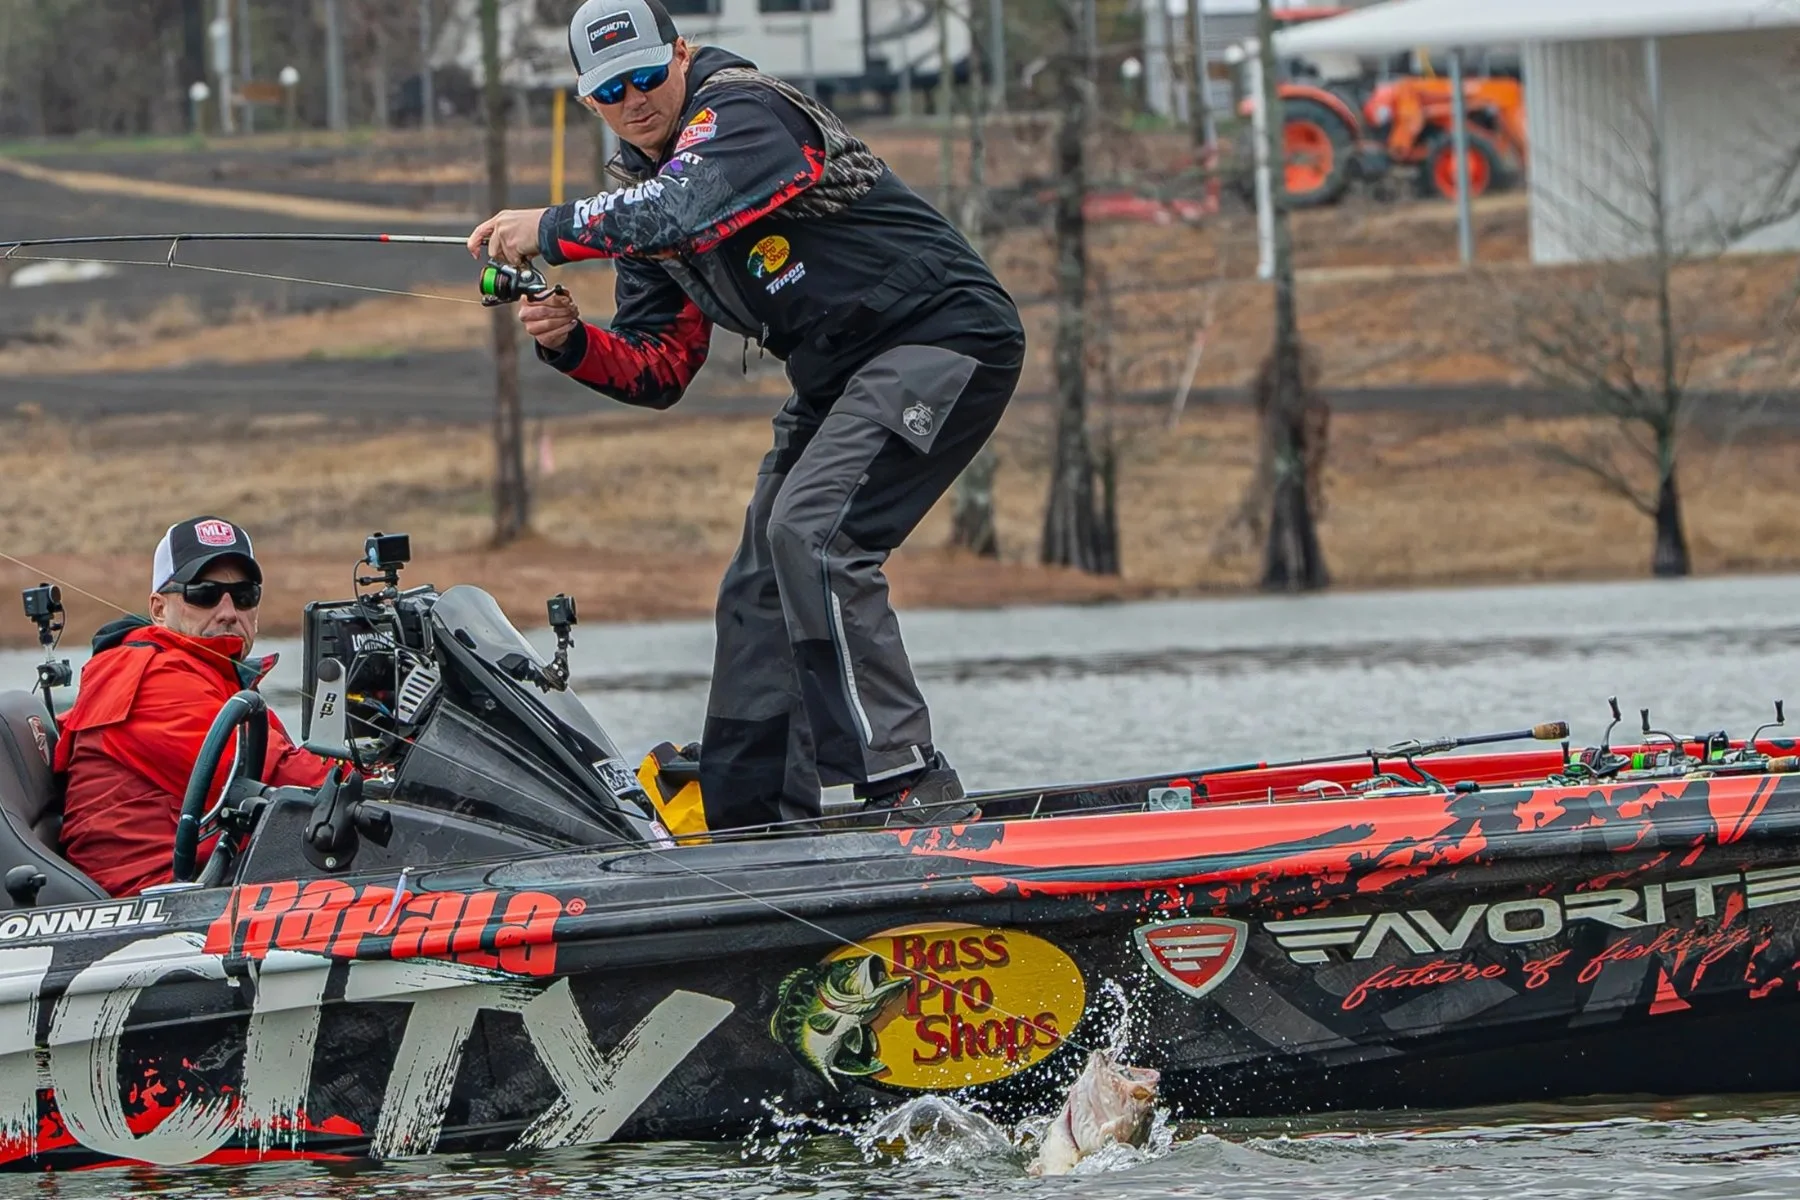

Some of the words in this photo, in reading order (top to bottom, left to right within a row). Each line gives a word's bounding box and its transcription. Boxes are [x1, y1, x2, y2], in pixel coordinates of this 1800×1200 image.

[766, 261, 804, 294] Triton
[200, 524, 231, 537] MLF
[1263, 865, 1800, 963] FAVORITE
[891, 933, 1010, 974] Bass
[902, 972, 994, 1021] Pro
[1341, 958, 1507, 1010] future
[1522, 948, 1572, 990] of
[912, 1011, 1062, 1067] Shops
